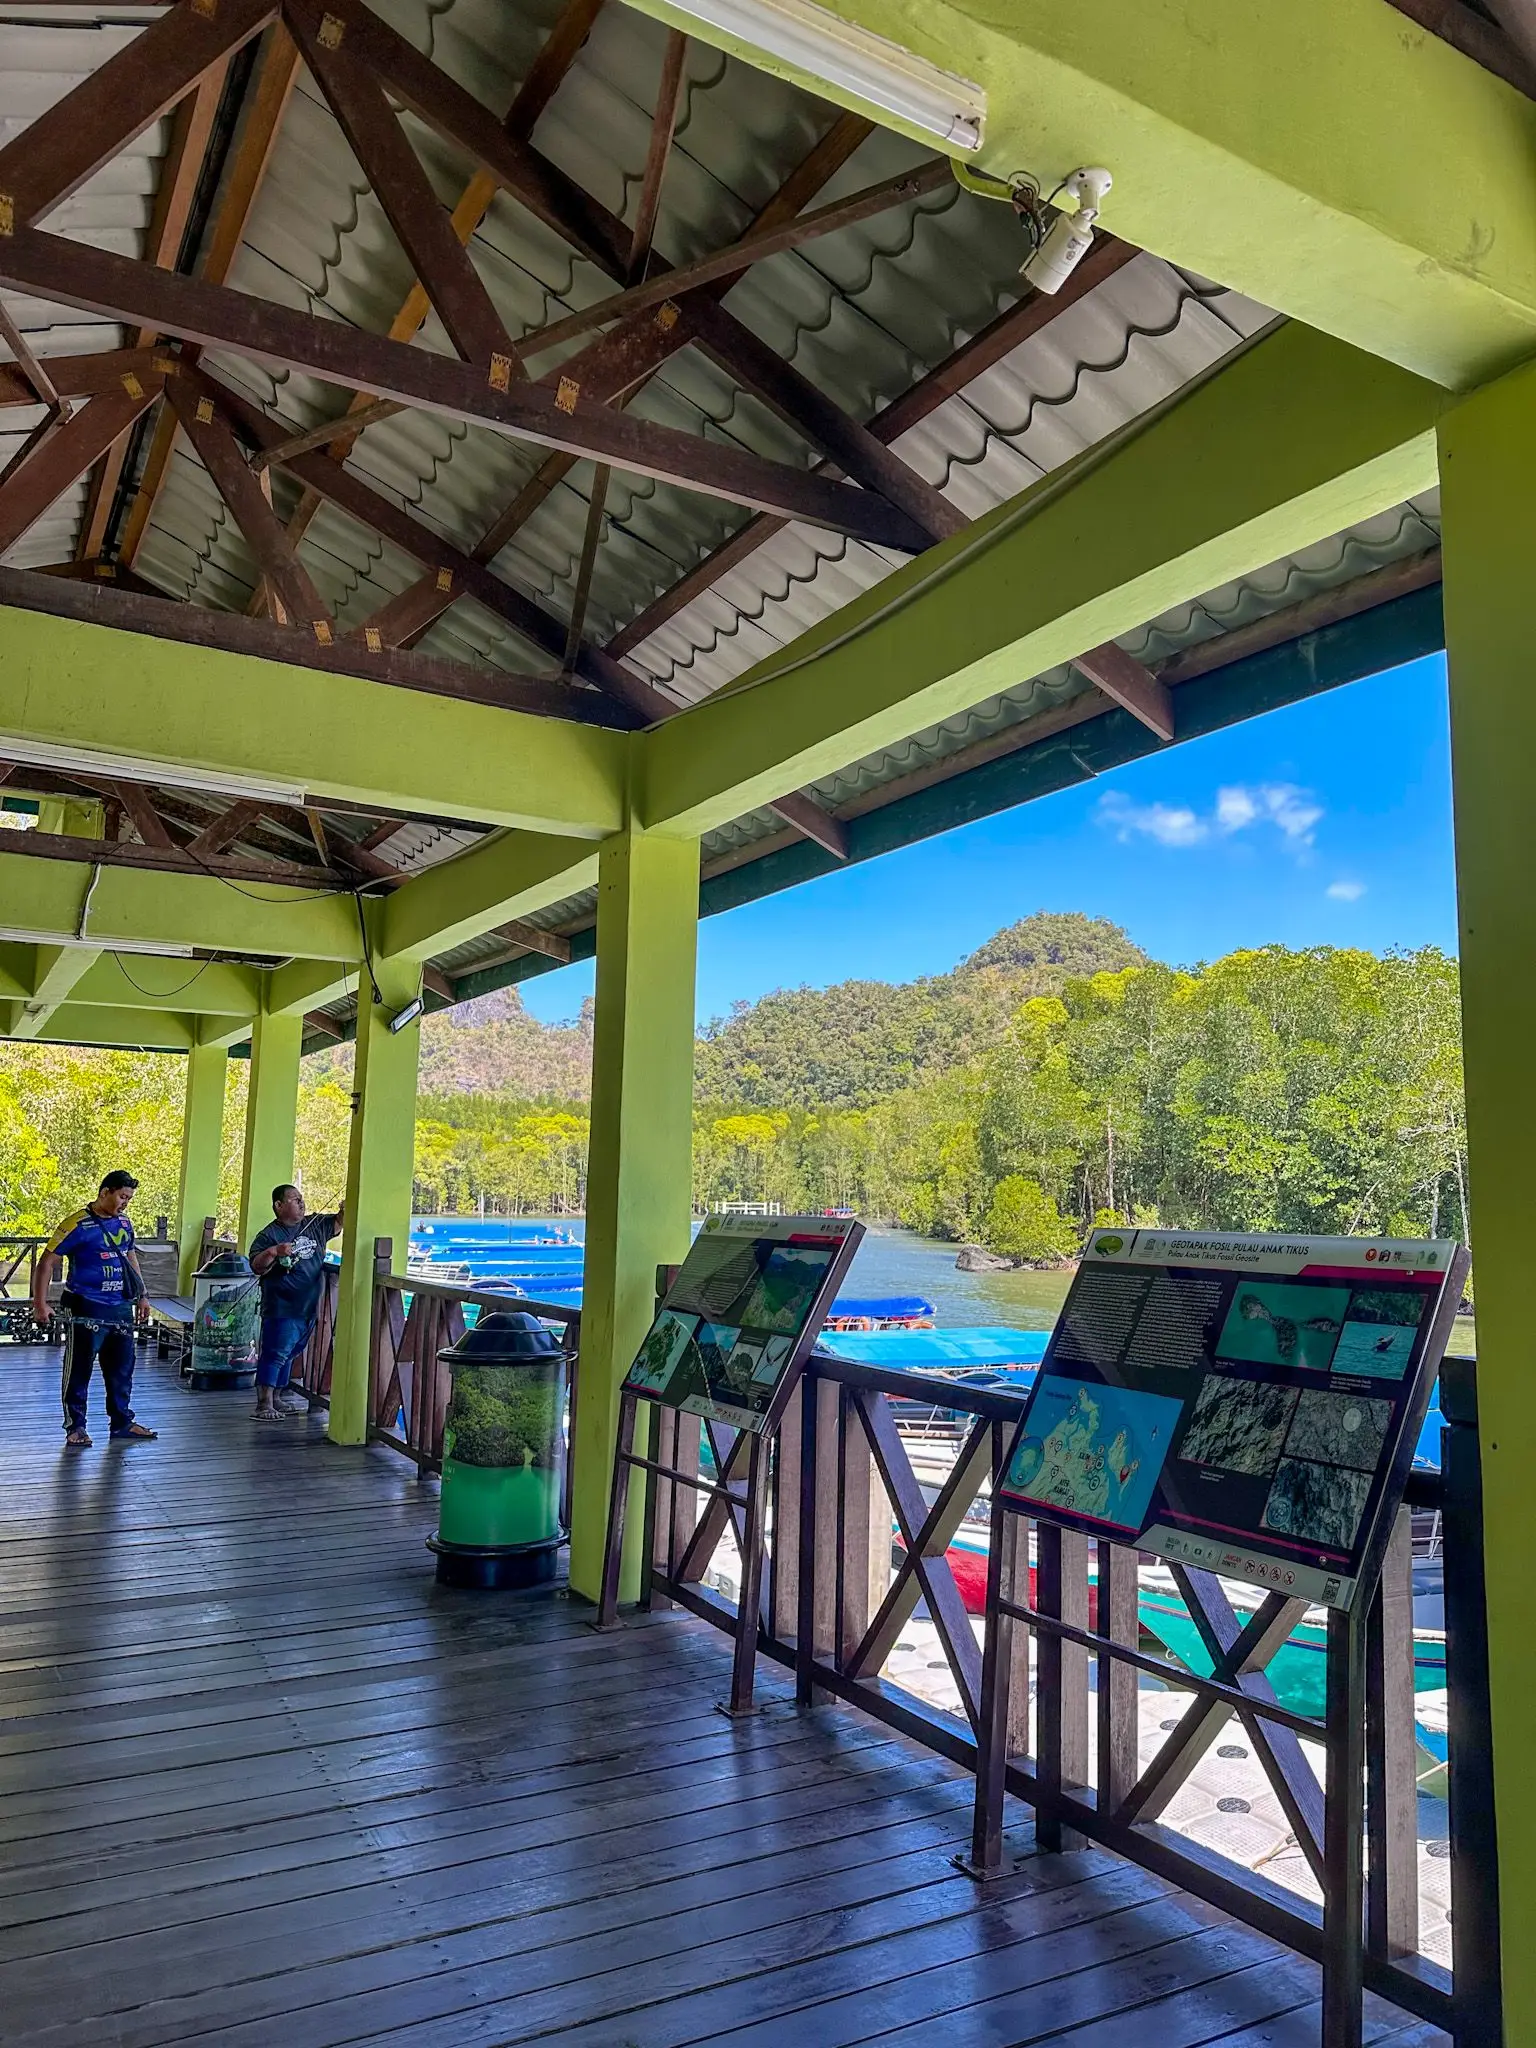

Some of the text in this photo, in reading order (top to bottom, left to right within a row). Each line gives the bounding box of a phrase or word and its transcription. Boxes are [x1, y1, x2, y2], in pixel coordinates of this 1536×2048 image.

[1170, 1240, 1310, 1255] GEOTAPAK FOSIL PULAU ANAK TIKUS
[1167, 1250, 1184, 1258] Pulau
[1184, 1251, 1201, 1259] Anak
[1201, 1252, 1216, 1260] Tikus
[1217, 1252, 1234, 1261] Fossil
[1235, 1253, 1260, 1262] Geosite
